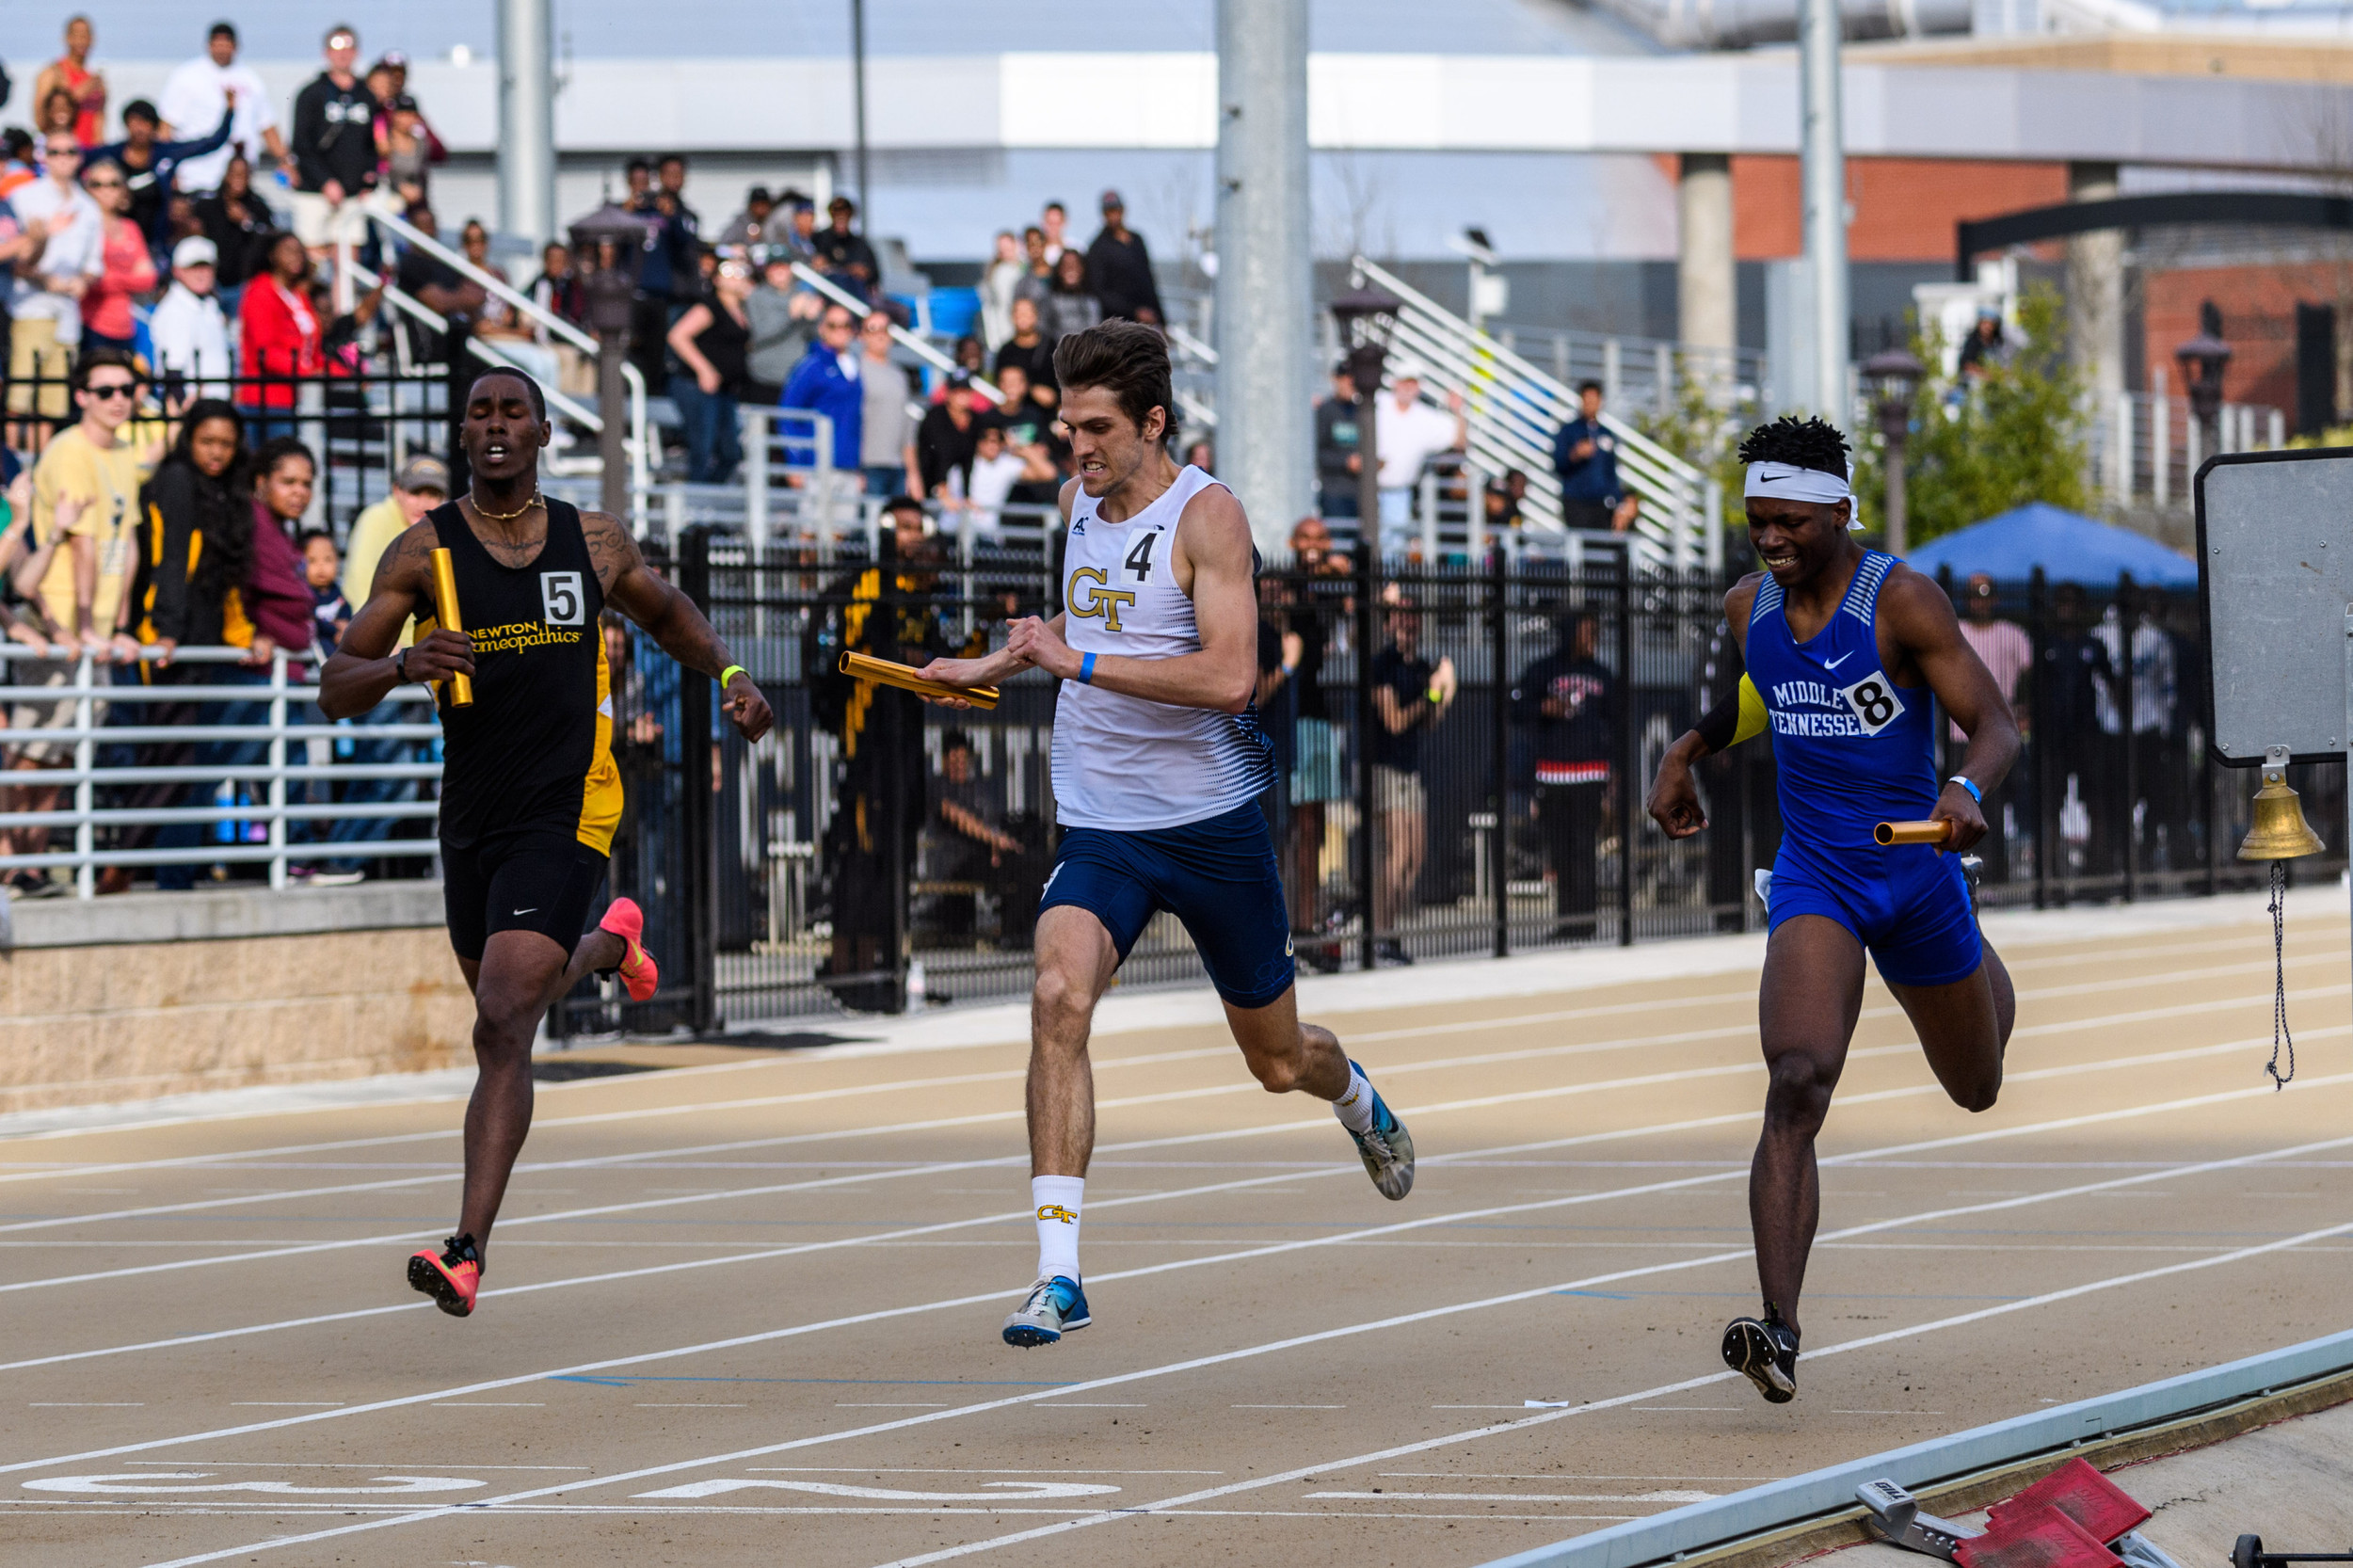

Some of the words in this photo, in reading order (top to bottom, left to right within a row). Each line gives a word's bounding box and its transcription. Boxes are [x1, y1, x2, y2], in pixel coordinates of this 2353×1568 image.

[1125, 533, 1157, 582] 4
[548, 576, 577, 621] 5
[1067, 567, 1135, 632] GT
[465, 620, 538, 640] NEWTON
[472, 618, 581, 654] omeopathics
[1772, 680, 1845, 711] MIDDLE
[1853, 681, 1894, 727] 8
[1769, 708, 1867, 737] TENNESSE
[1037, 1205, 1078, 1224] GT
[1874, 1481, 1907, 1500] GILL
